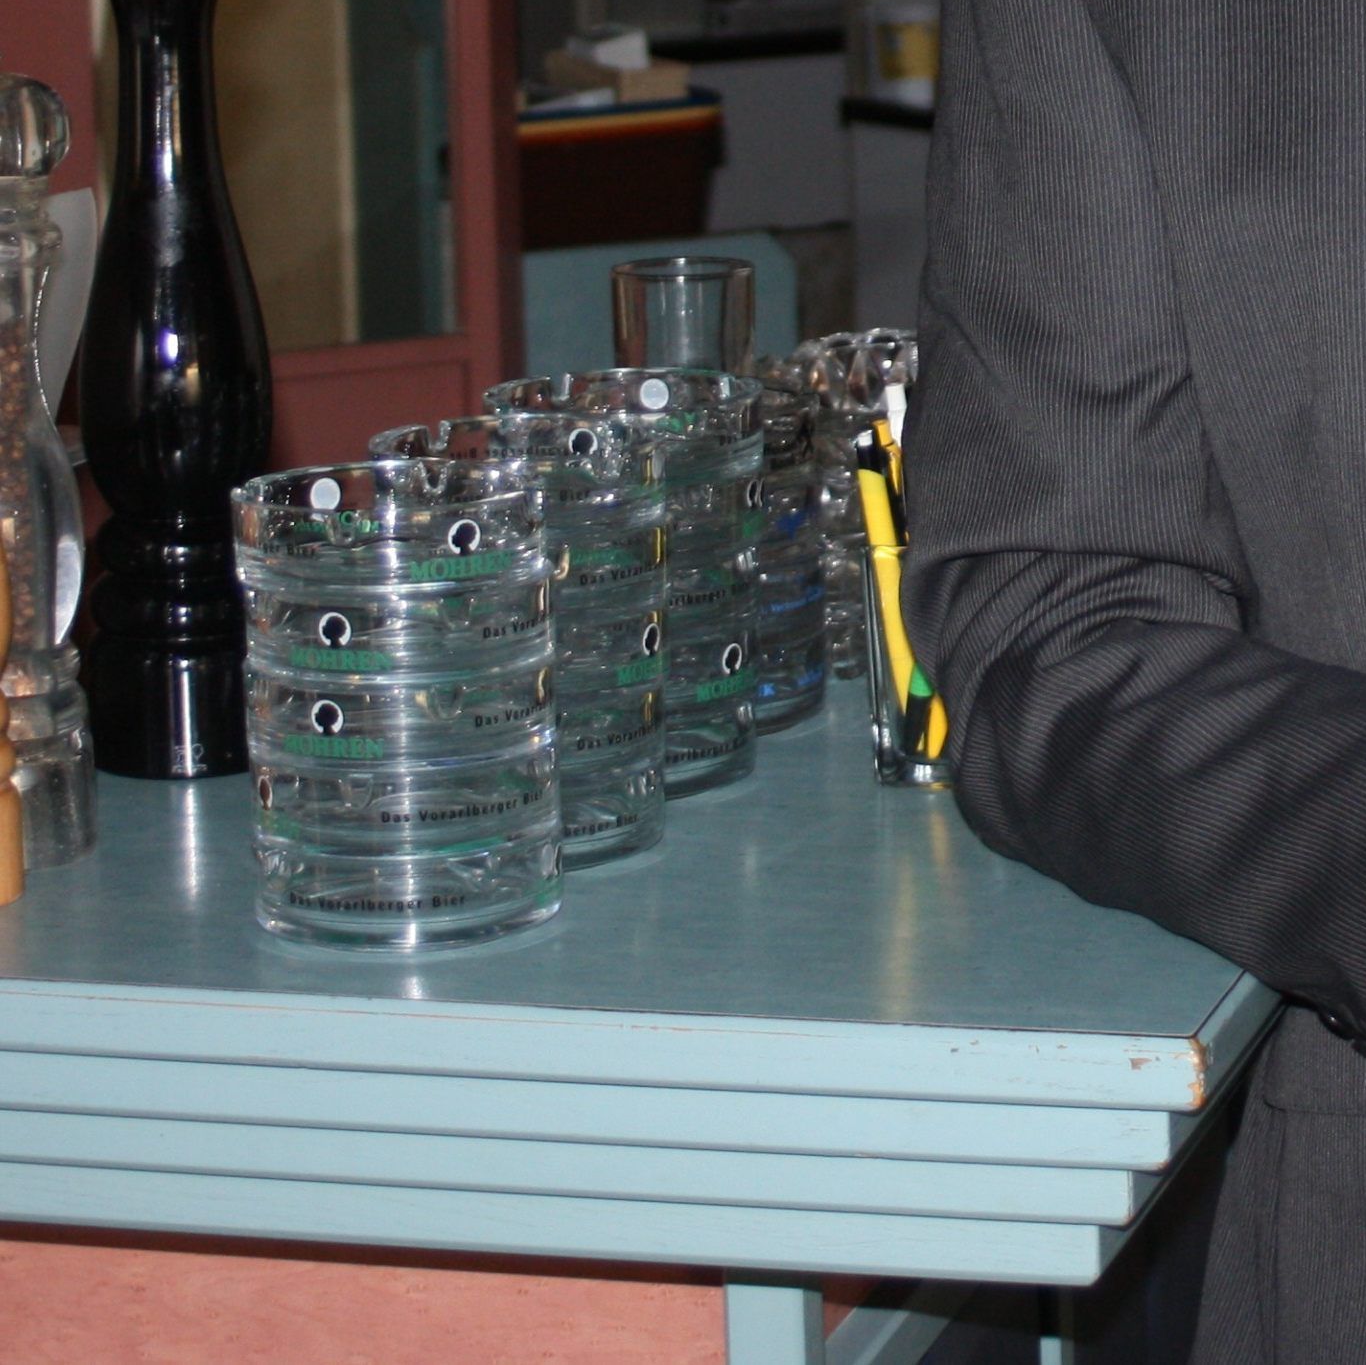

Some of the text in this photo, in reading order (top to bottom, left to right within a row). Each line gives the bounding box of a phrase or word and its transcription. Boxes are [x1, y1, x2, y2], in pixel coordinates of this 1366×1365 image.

[409, 551, 513, 582] MOHREN
[380, 810, 411, 824] Das
[418, 797, 518, 822] Vorarlberger
[319, 897, 424, 913] Vorarlberger
[431, 894, 466, 908] Bier
